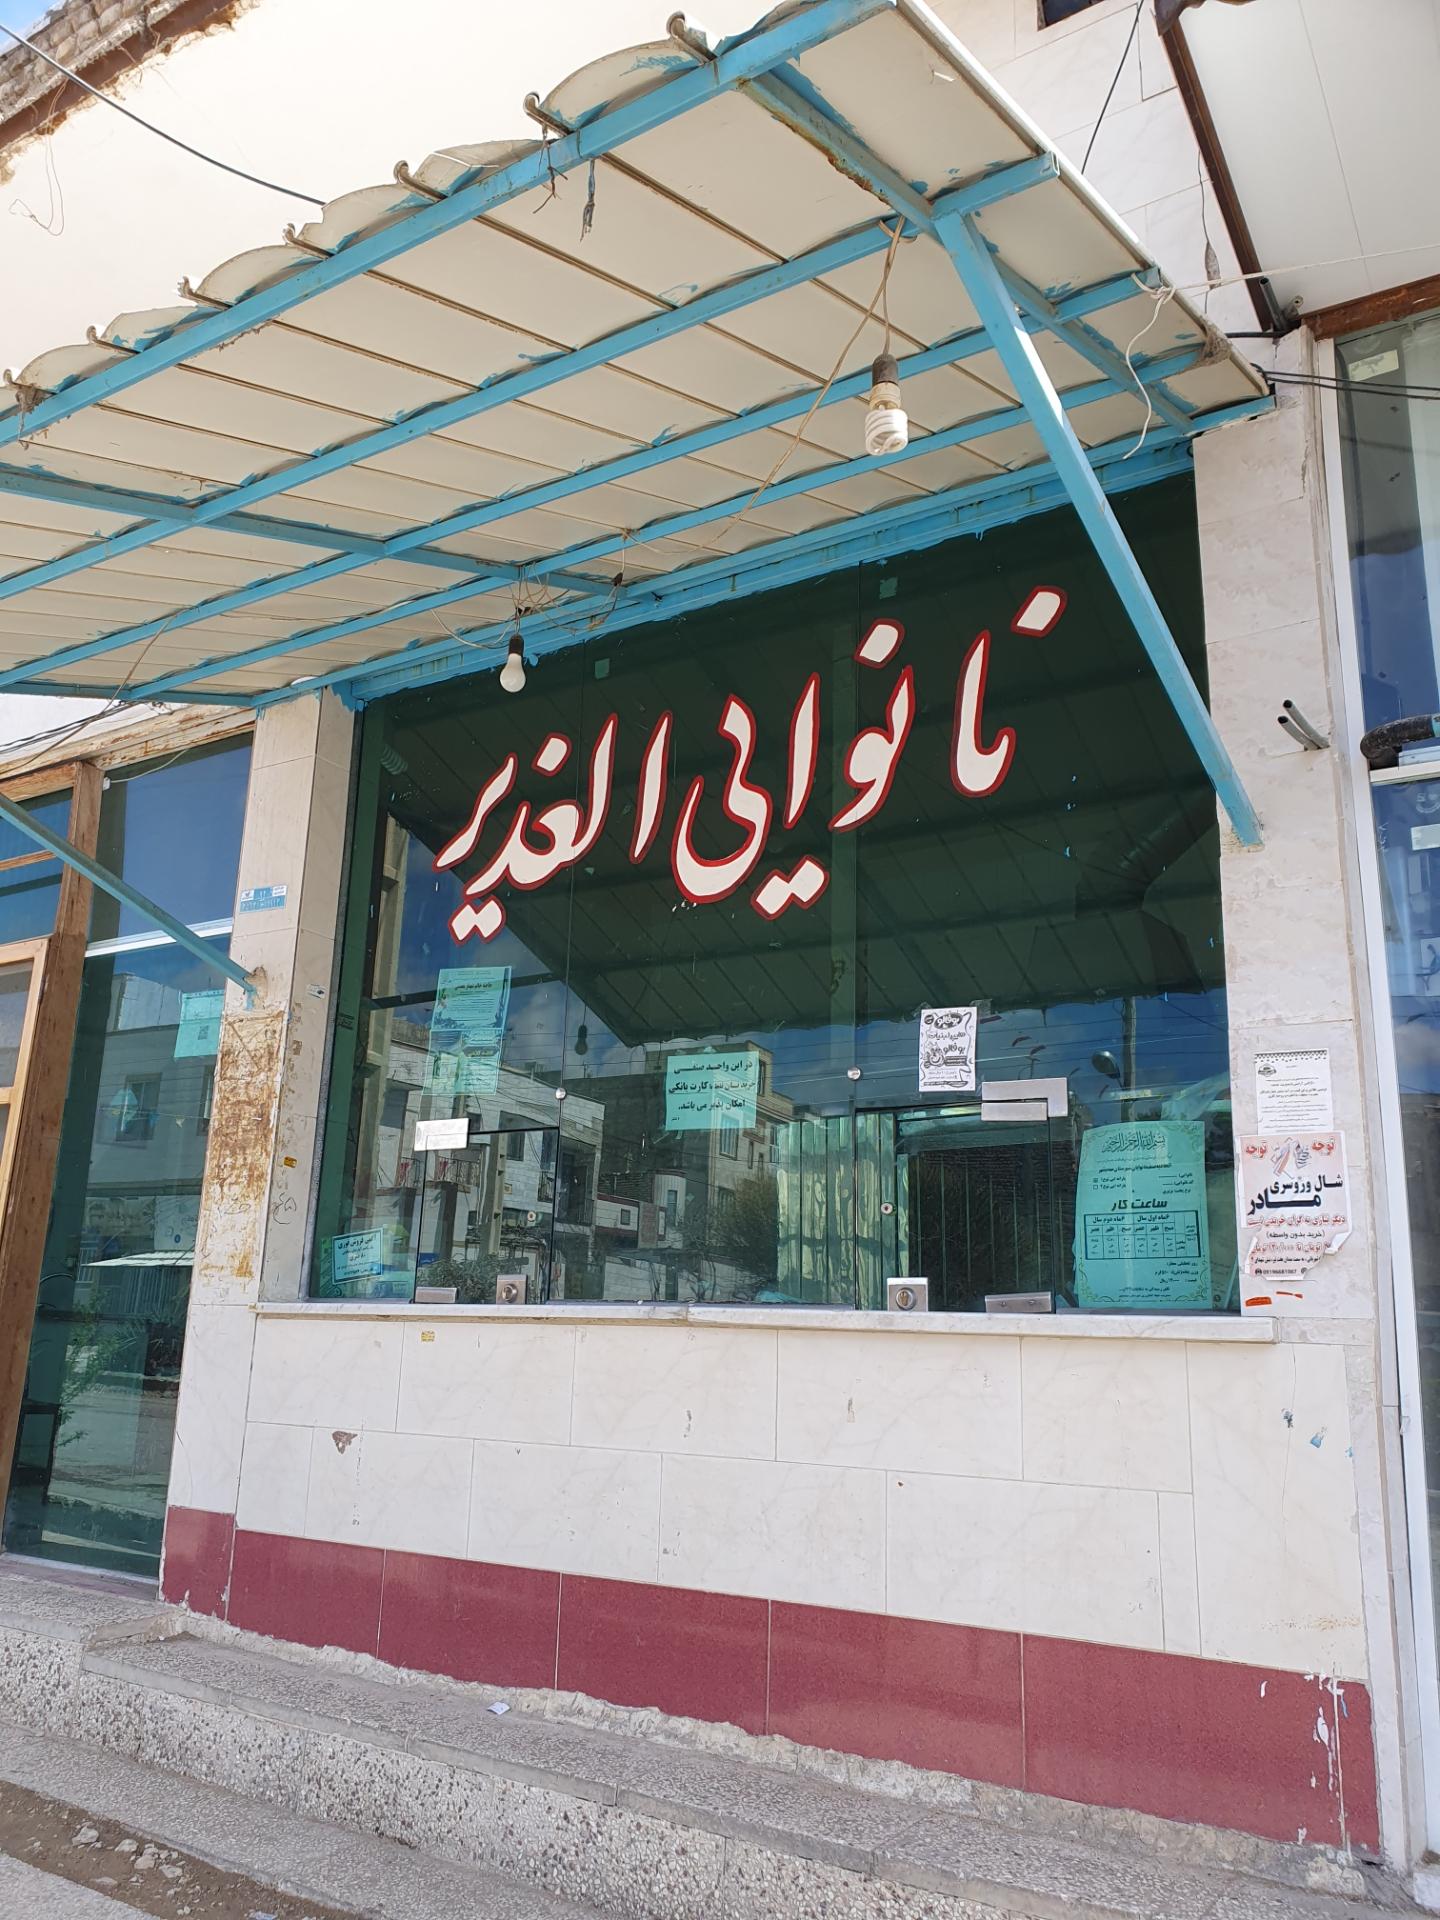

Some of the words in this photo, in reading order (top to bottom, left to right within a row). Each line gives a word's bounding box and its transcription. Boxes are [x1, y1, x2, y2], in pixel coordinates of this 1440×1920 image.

[706, 1061, 730, 1073] واحد
[730, 1060, 743, 1072] این
[744, 1061, 753, 1072] در
[668, 1082, 689, 1095] بانکی
[690, 1081, 709, 1093] کارت
[696, 1103, 707, 1112] می
[726, 1099, 746, 1111] امکان
[1314, 1173, 1343, 1192] شال
[1111, 1199, 1128, 1212] کار
[1131, 1198, 1168, 1209] ساعت
[1247, 1187, 1321, 1215] مادر
